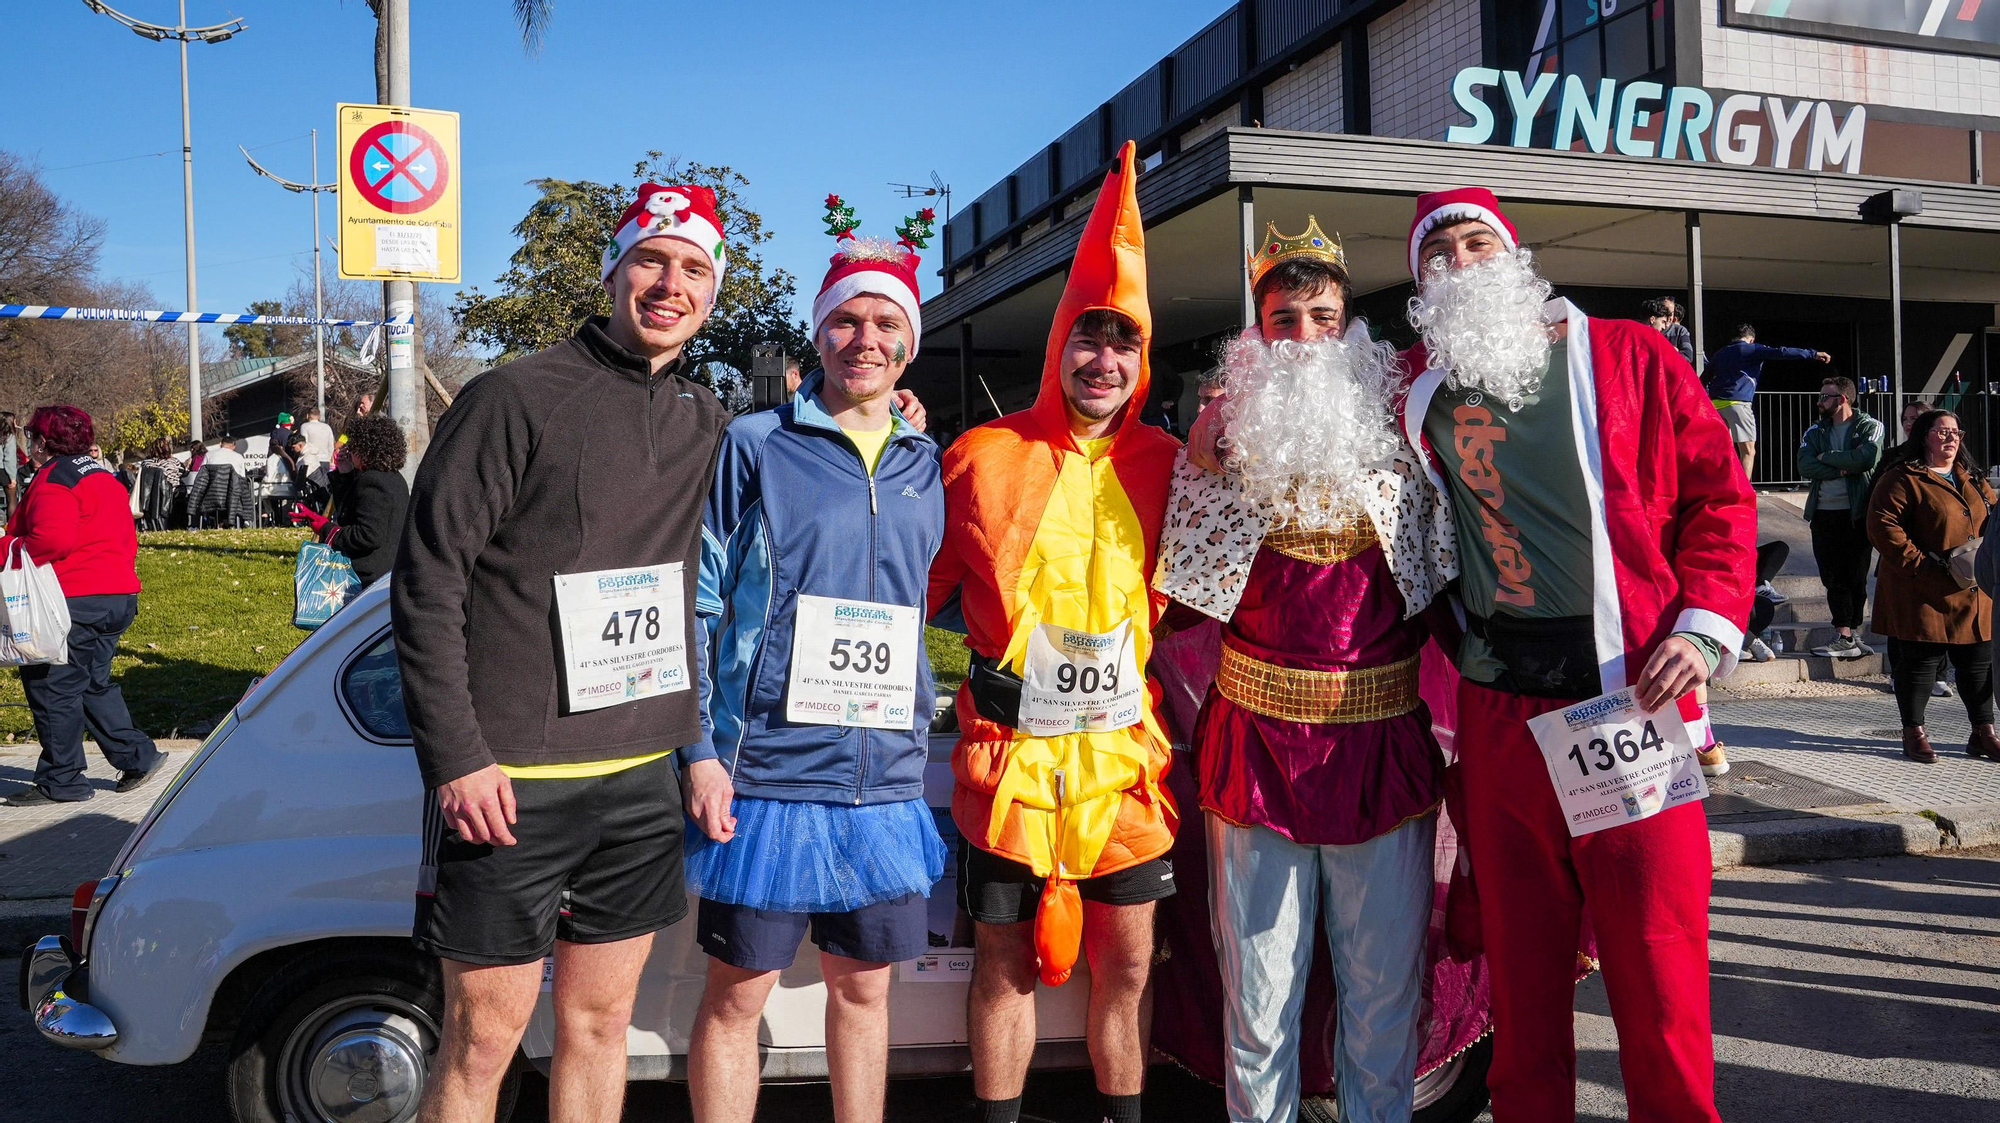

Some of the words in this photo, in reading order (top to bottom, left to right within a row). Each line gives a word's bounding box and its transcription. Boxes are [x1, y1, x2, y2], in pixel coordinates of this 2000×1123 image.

[1446, 67, 1867, 175] SYNERGYM
[348, 216, 404, 226] Ayuntamiento
[406, 218, 416, 226] de
[117, 309, 148, 322] LOCAL
[601, 606, 661, 646] 478
[593, 658, 608, 667] SAN
[610, 652, 647, 665] SILVESTRE
[647, 644, 684, 658] CORDOBESA
[829, 638, 891, 675] 539
[662, 669, 678, 679] GCC
[1057, 663, 1118, 694] 903
[587, 682, 622, 695] IMDECO
[815, 678, 830, 686] SAN
[832, 680, 873, 690] SILVESTRE
[874, 683, 913, 692] CORDOBESA
[804, 702, 841, 712] IMDECO
[1043, 697, 1059, 706] SAN
[889, 708, 905, 716] GCC
[1117, 708, 1132, 718] GCC
[1035, 717, 1070, 726] IMDECO
[1568, 720, 1664, 777] 1364
[1579, 785, 1595, 794] SAN
[1596, 771, 1640, 790] SILVESTRE
[1641, 753, 1693, 775] CORDOBESA
[1600, 784, 1632, 797] ALEJANDRO
[1633, 774, 1658, 787] ROMERO
[1671, 779, 1692, 790] GCC
[1671, 793, 1685, 801] SPORT
[1582, 804, 1618, 819] IMDECO
